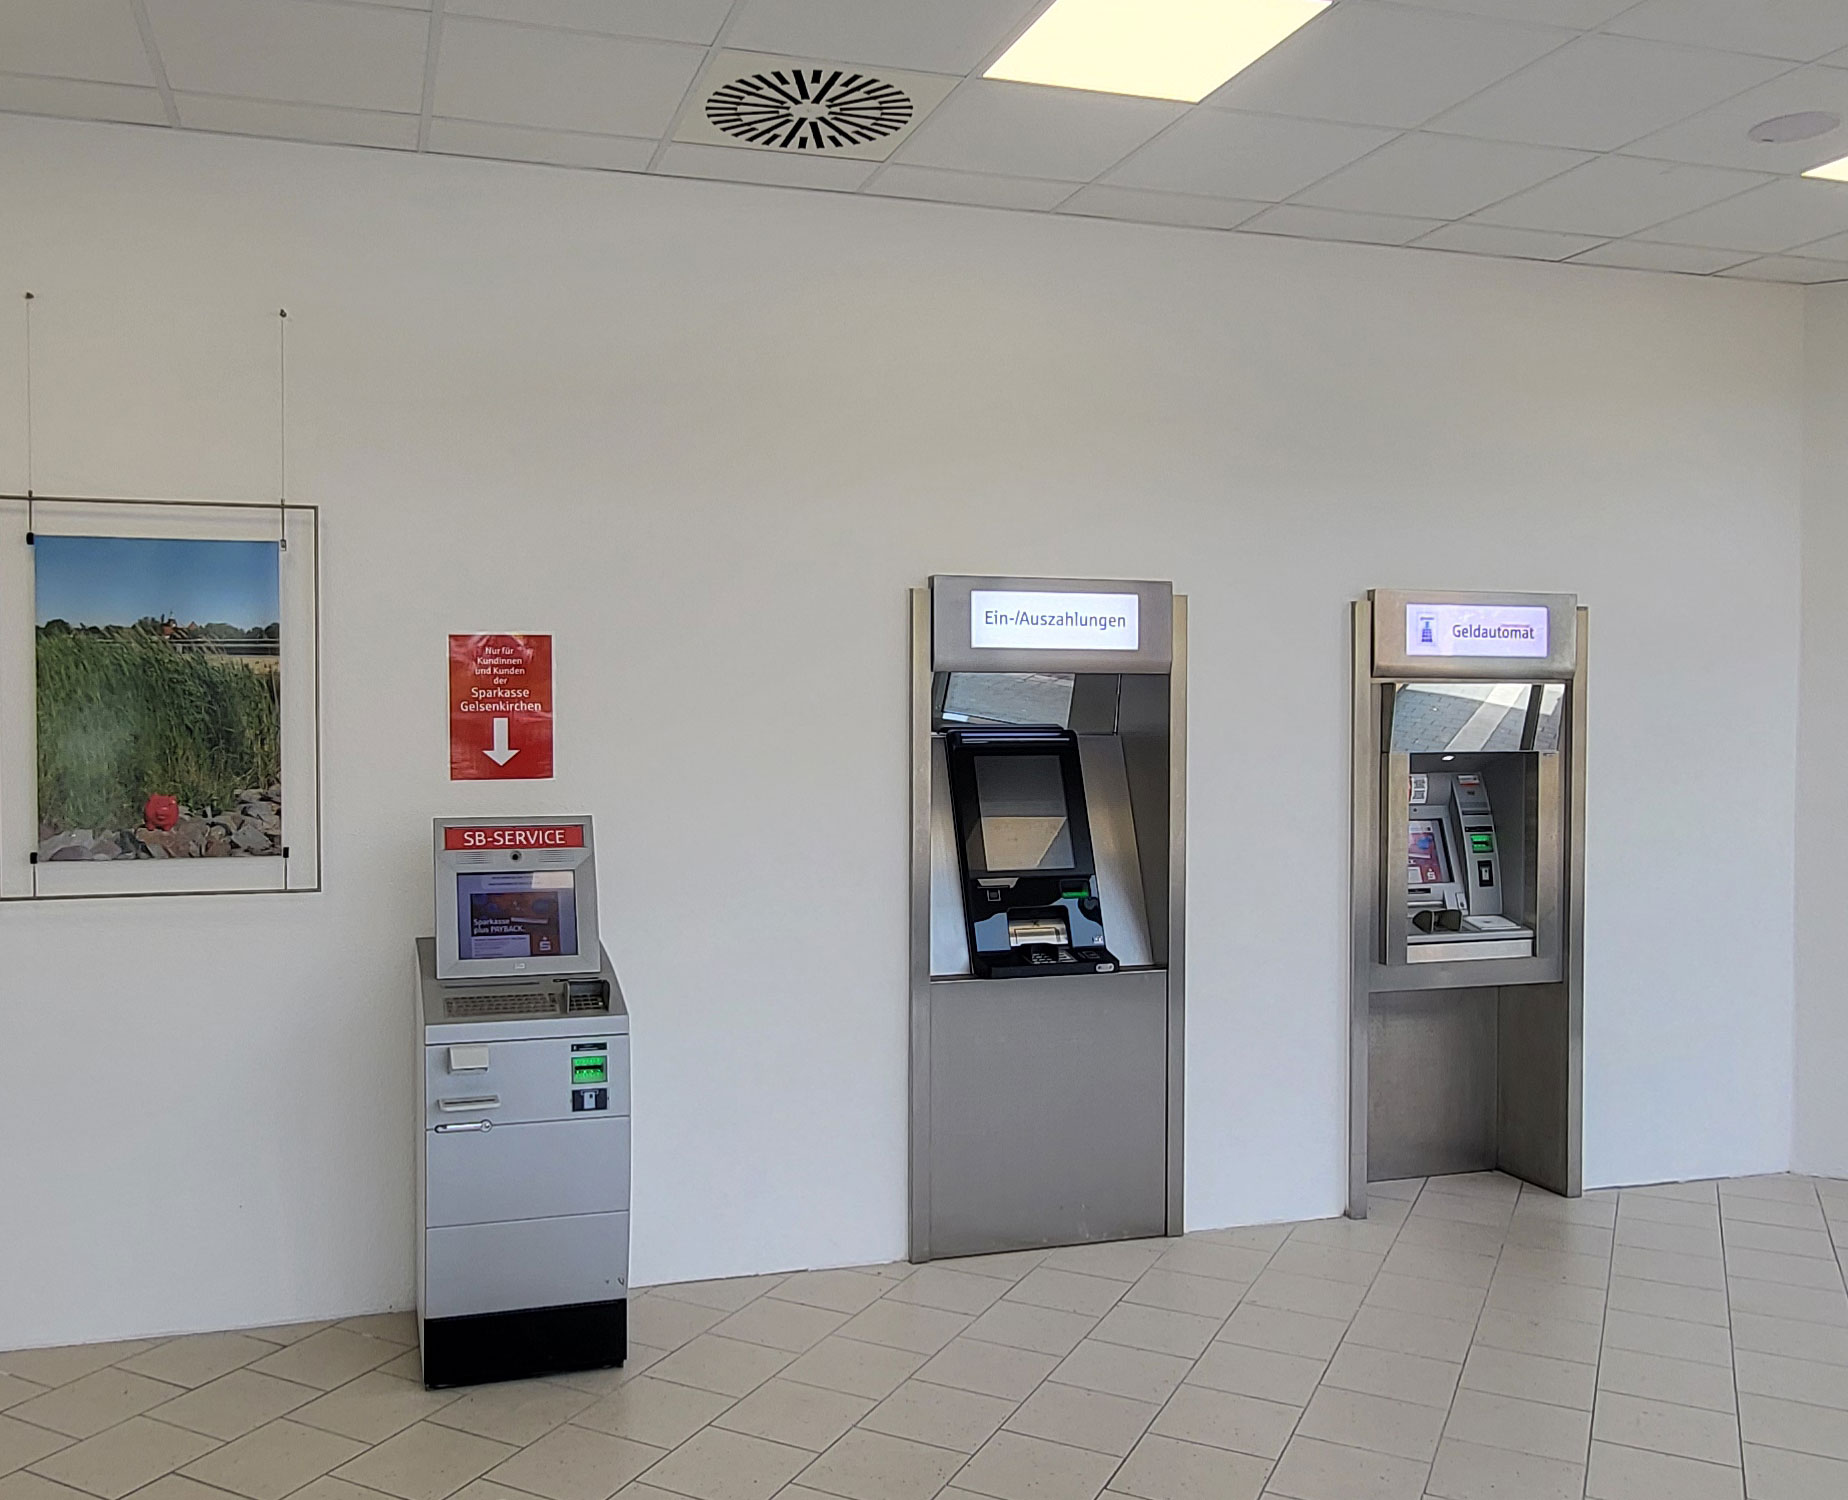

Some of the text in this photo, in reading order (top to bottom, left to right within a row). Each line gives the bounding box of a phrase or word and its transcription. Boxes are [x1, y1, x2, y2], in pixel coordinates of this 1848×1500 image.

[985, 610, 1127, 630] Ein-/Auszahlungen
[1452, 624, 1535, 640] Geldautomat
[485, 647, 514, 655] Nur für
[477, 656, 523, 665] Kundinnen
[475, 667, 525, 675] und Kunden
[493, 676, 508, 685] der
[471, 687, 530, 699] Sparkasse
[460, 701, 542, 712] Gelsenkirchen
[463, 830, 566, 846] SB-SERVICE
[473, 918, 510, 927] Sparkasse
